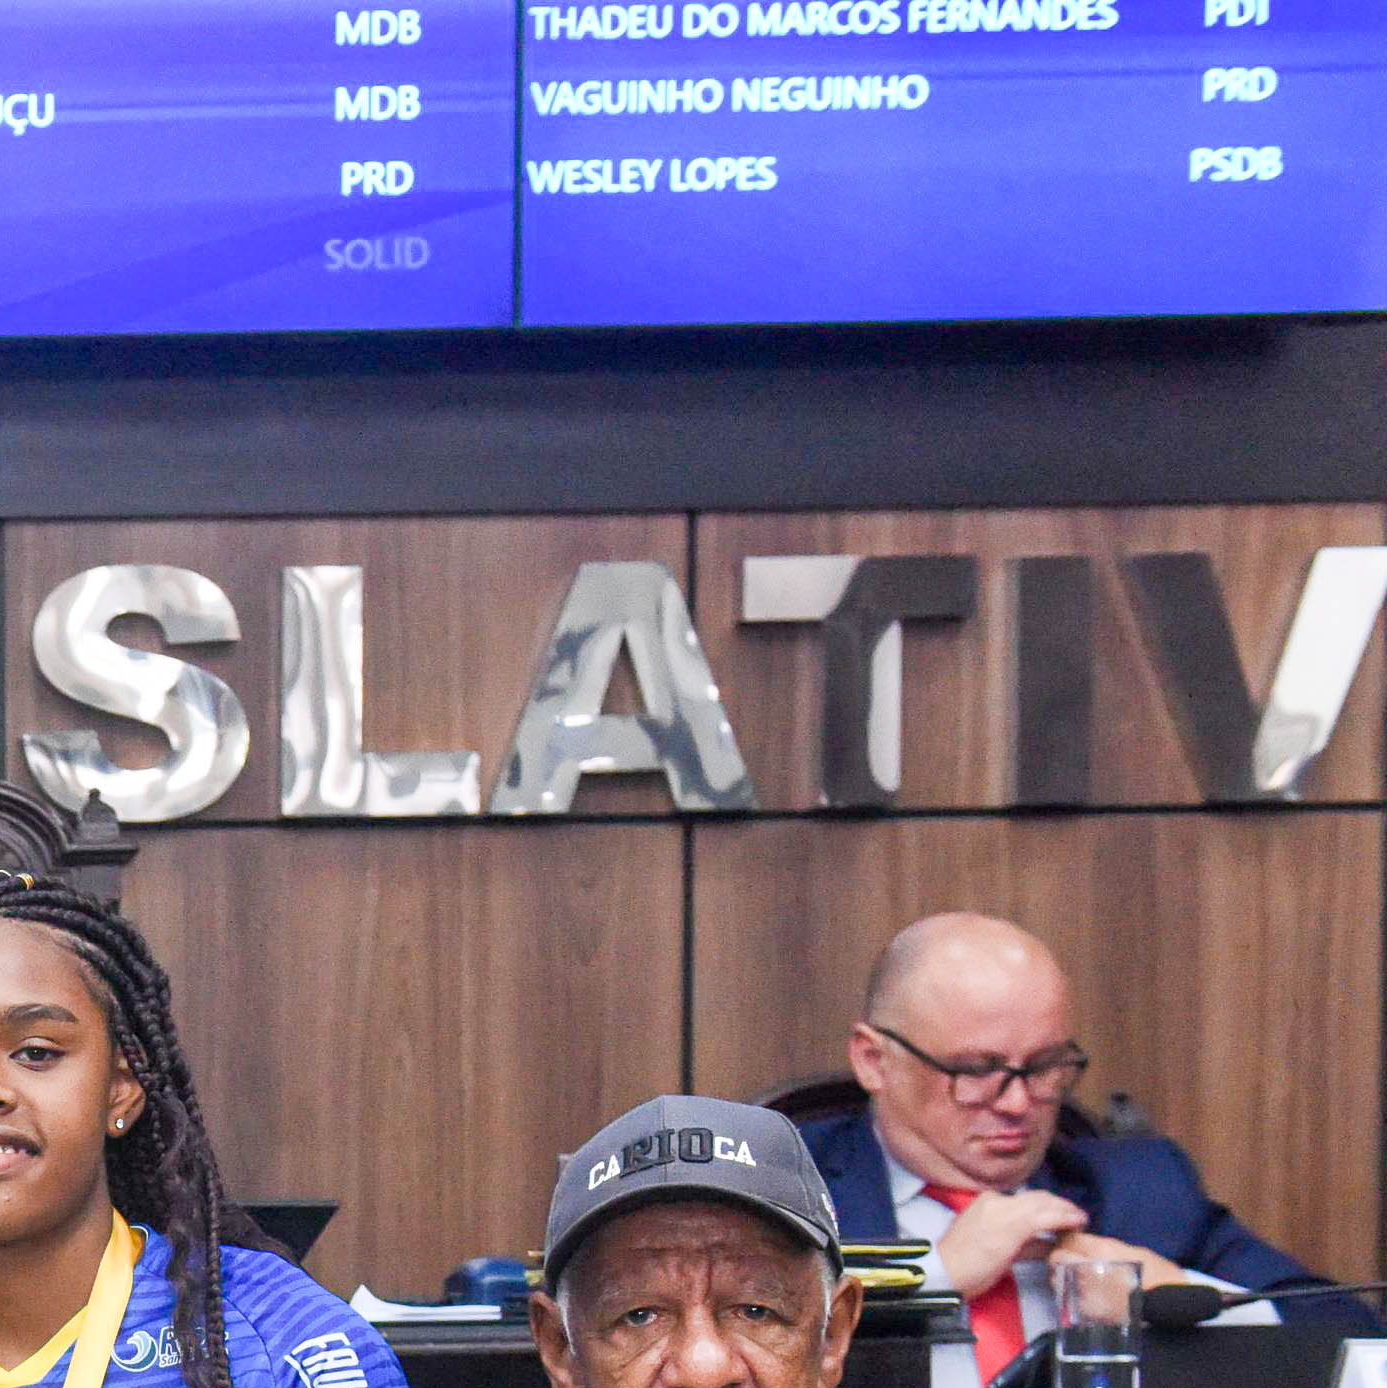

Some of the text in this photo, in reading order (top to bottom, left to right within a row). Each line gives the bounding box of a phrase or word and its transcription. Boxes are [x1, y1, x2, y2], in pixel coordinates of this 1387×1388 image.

[335, 9, 422, 45] MDB
[528, 0, 1119, 41] THADEU DO MARCOS FERNANDES
[335, 84, 421, 121] MDB
[530, 74, 930, 115] VAGUINHO NEGUINHO
[1202, 66, 1278, 102] PRD
[341, 160, 415, 196] PRD
[526, 156, 778, 194] WESLEY LOPES
[1189, 146, 1283, 182] PSDB
[324, 236, 431, 273] SOLID
[587, 1127, 757, 1191] CARIOCA
